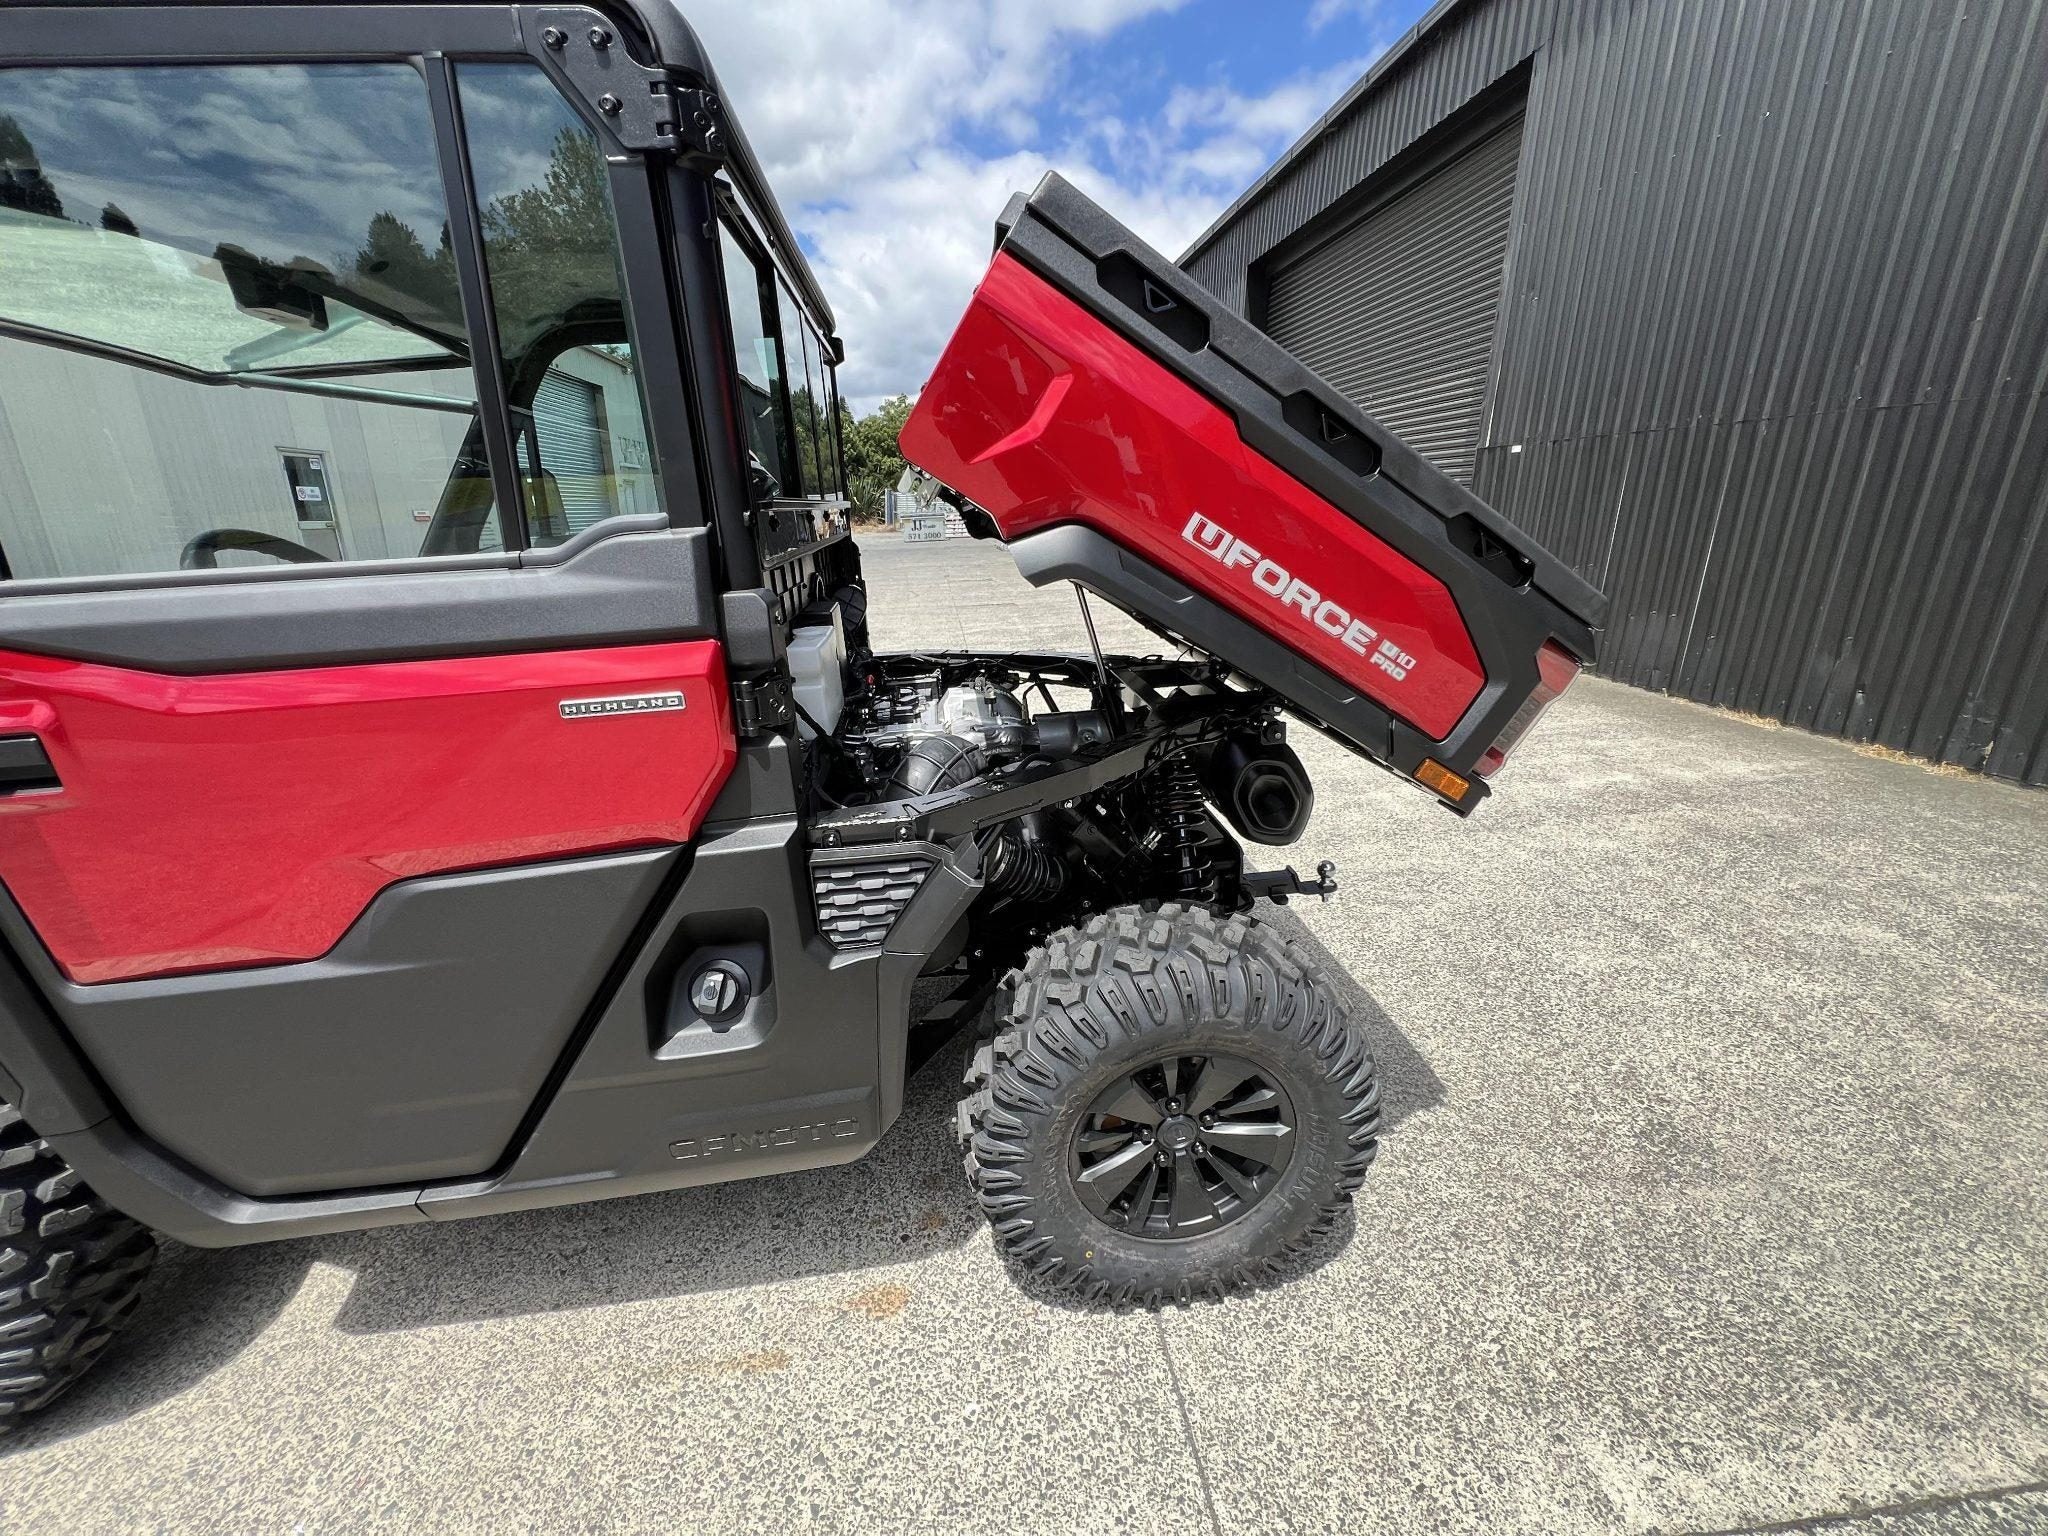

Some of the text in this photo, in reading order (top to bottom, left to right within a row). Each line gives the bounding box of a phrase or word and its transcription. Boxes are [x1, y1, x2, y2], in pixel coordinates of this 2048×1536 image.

[1181, 511, 1378, 656] UFORCE
[1369, 653, 1408, 682] PRO
[564, 696, 680, 714] HIGHLAND
[668, 1116, 860, 1160] CFMOTO
